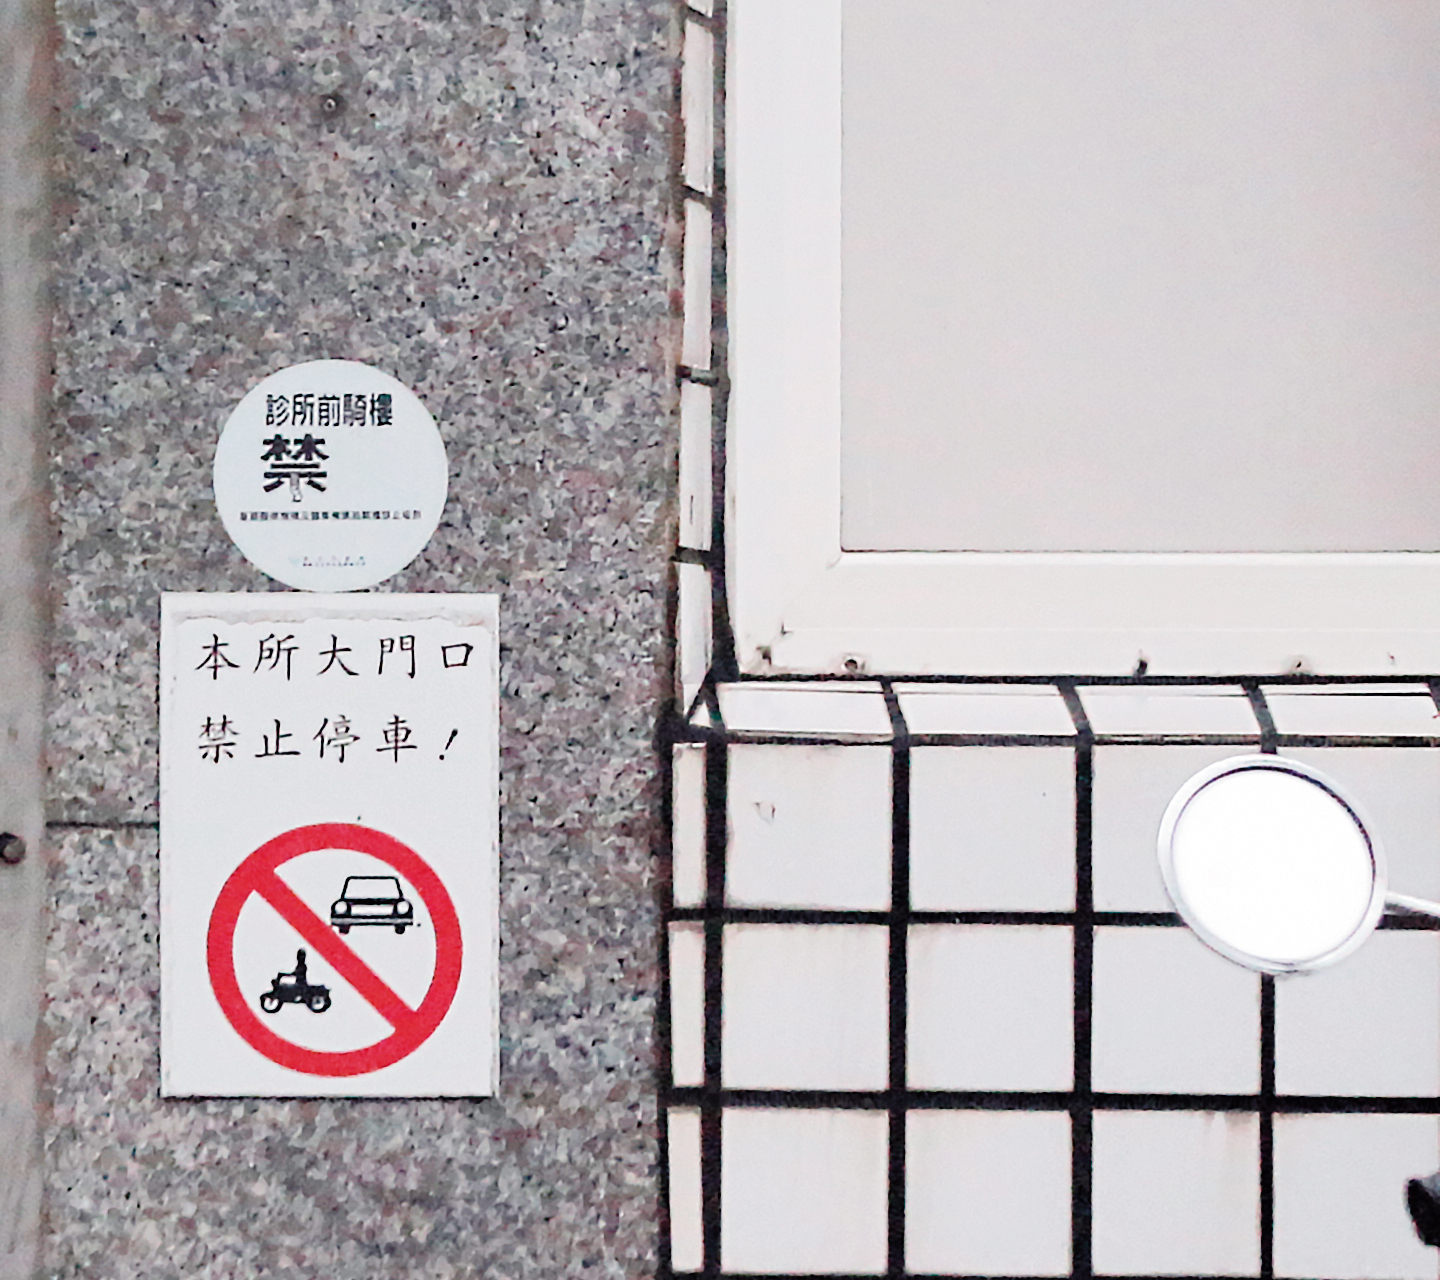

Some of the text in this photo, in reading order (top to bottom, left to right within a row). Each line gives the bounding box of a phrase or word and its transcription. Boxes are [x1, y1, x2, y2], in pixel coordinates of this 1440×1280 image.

[266, 393, 392, 427] 診所前騎樓
[260, 433, 330, 502] 禁
[195, 633, 474, 681] 本所大門口
[198, 714, 458, 763] 禁止停車!
